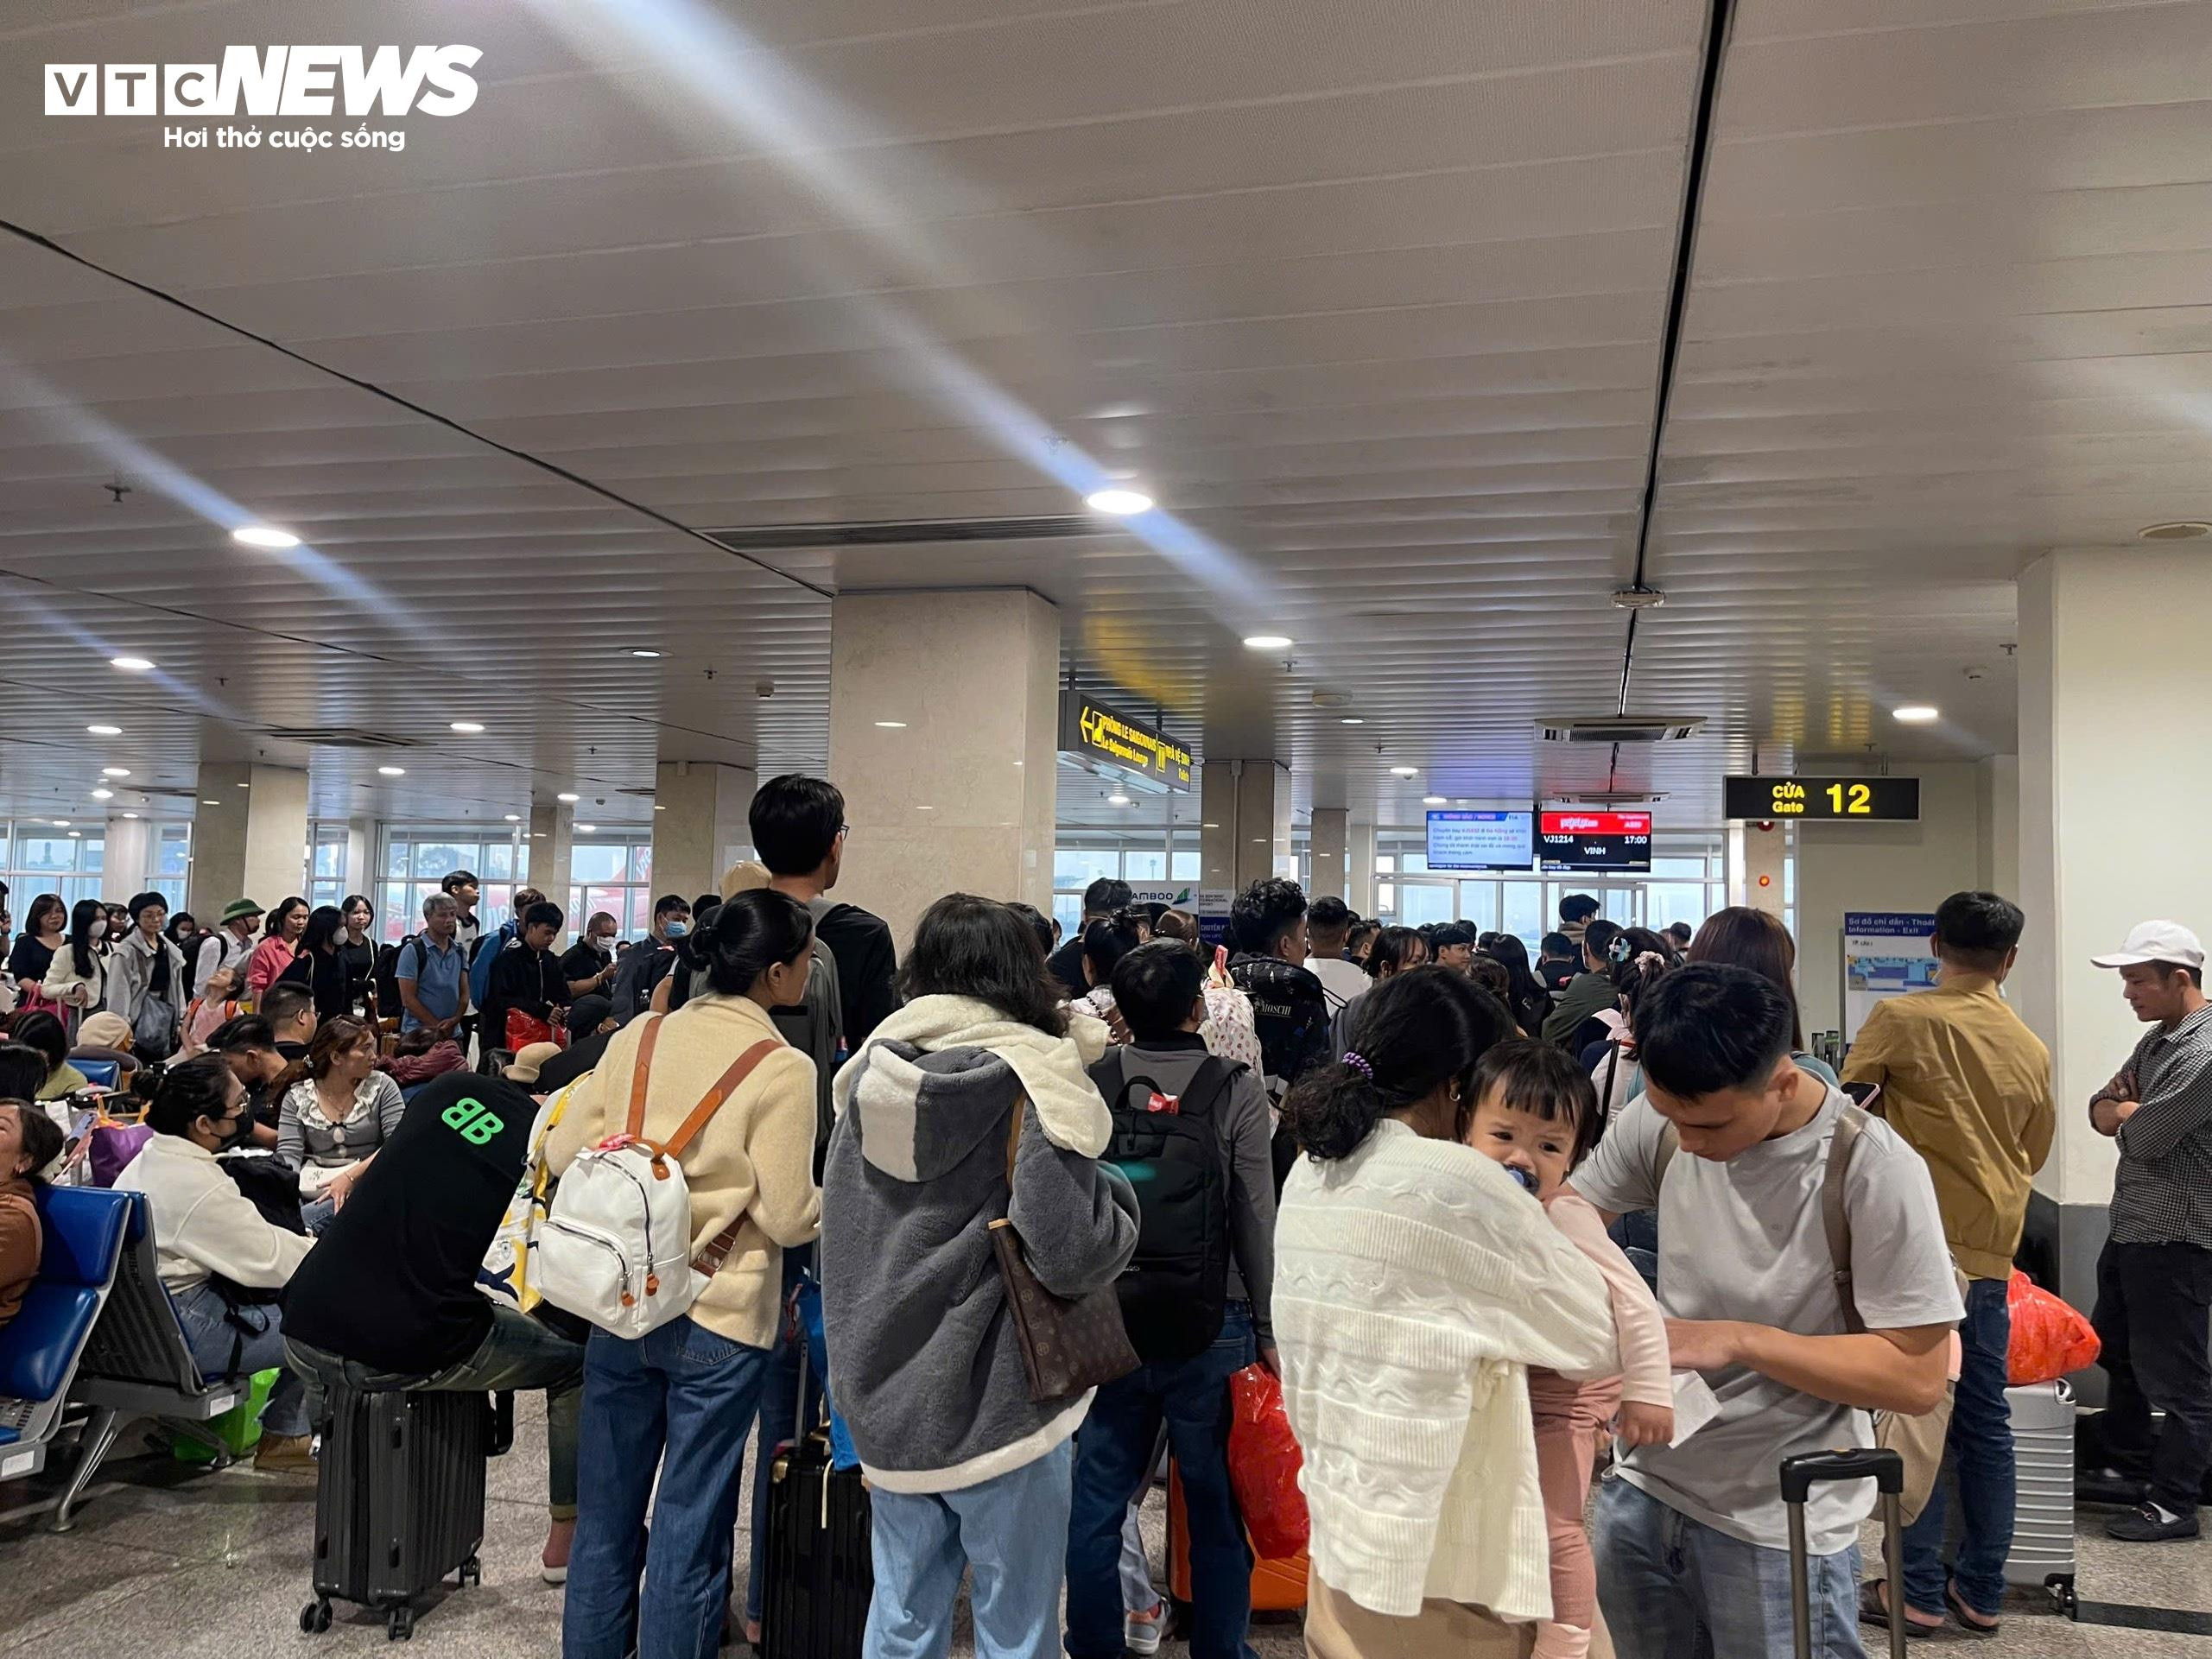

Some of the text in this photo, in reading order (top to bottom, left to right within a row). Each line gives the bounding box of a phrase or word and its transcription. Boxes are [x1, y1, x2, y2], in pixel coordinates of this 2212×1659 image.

[1772, 781, 1805, 799] CỬA
[1826, 783, 1871, 814] 12
[1772, 801, 1804, 814] Gate
[1624, 835, 1647, 845] 17:00
[1583, 846, 1607, 855] VINH
